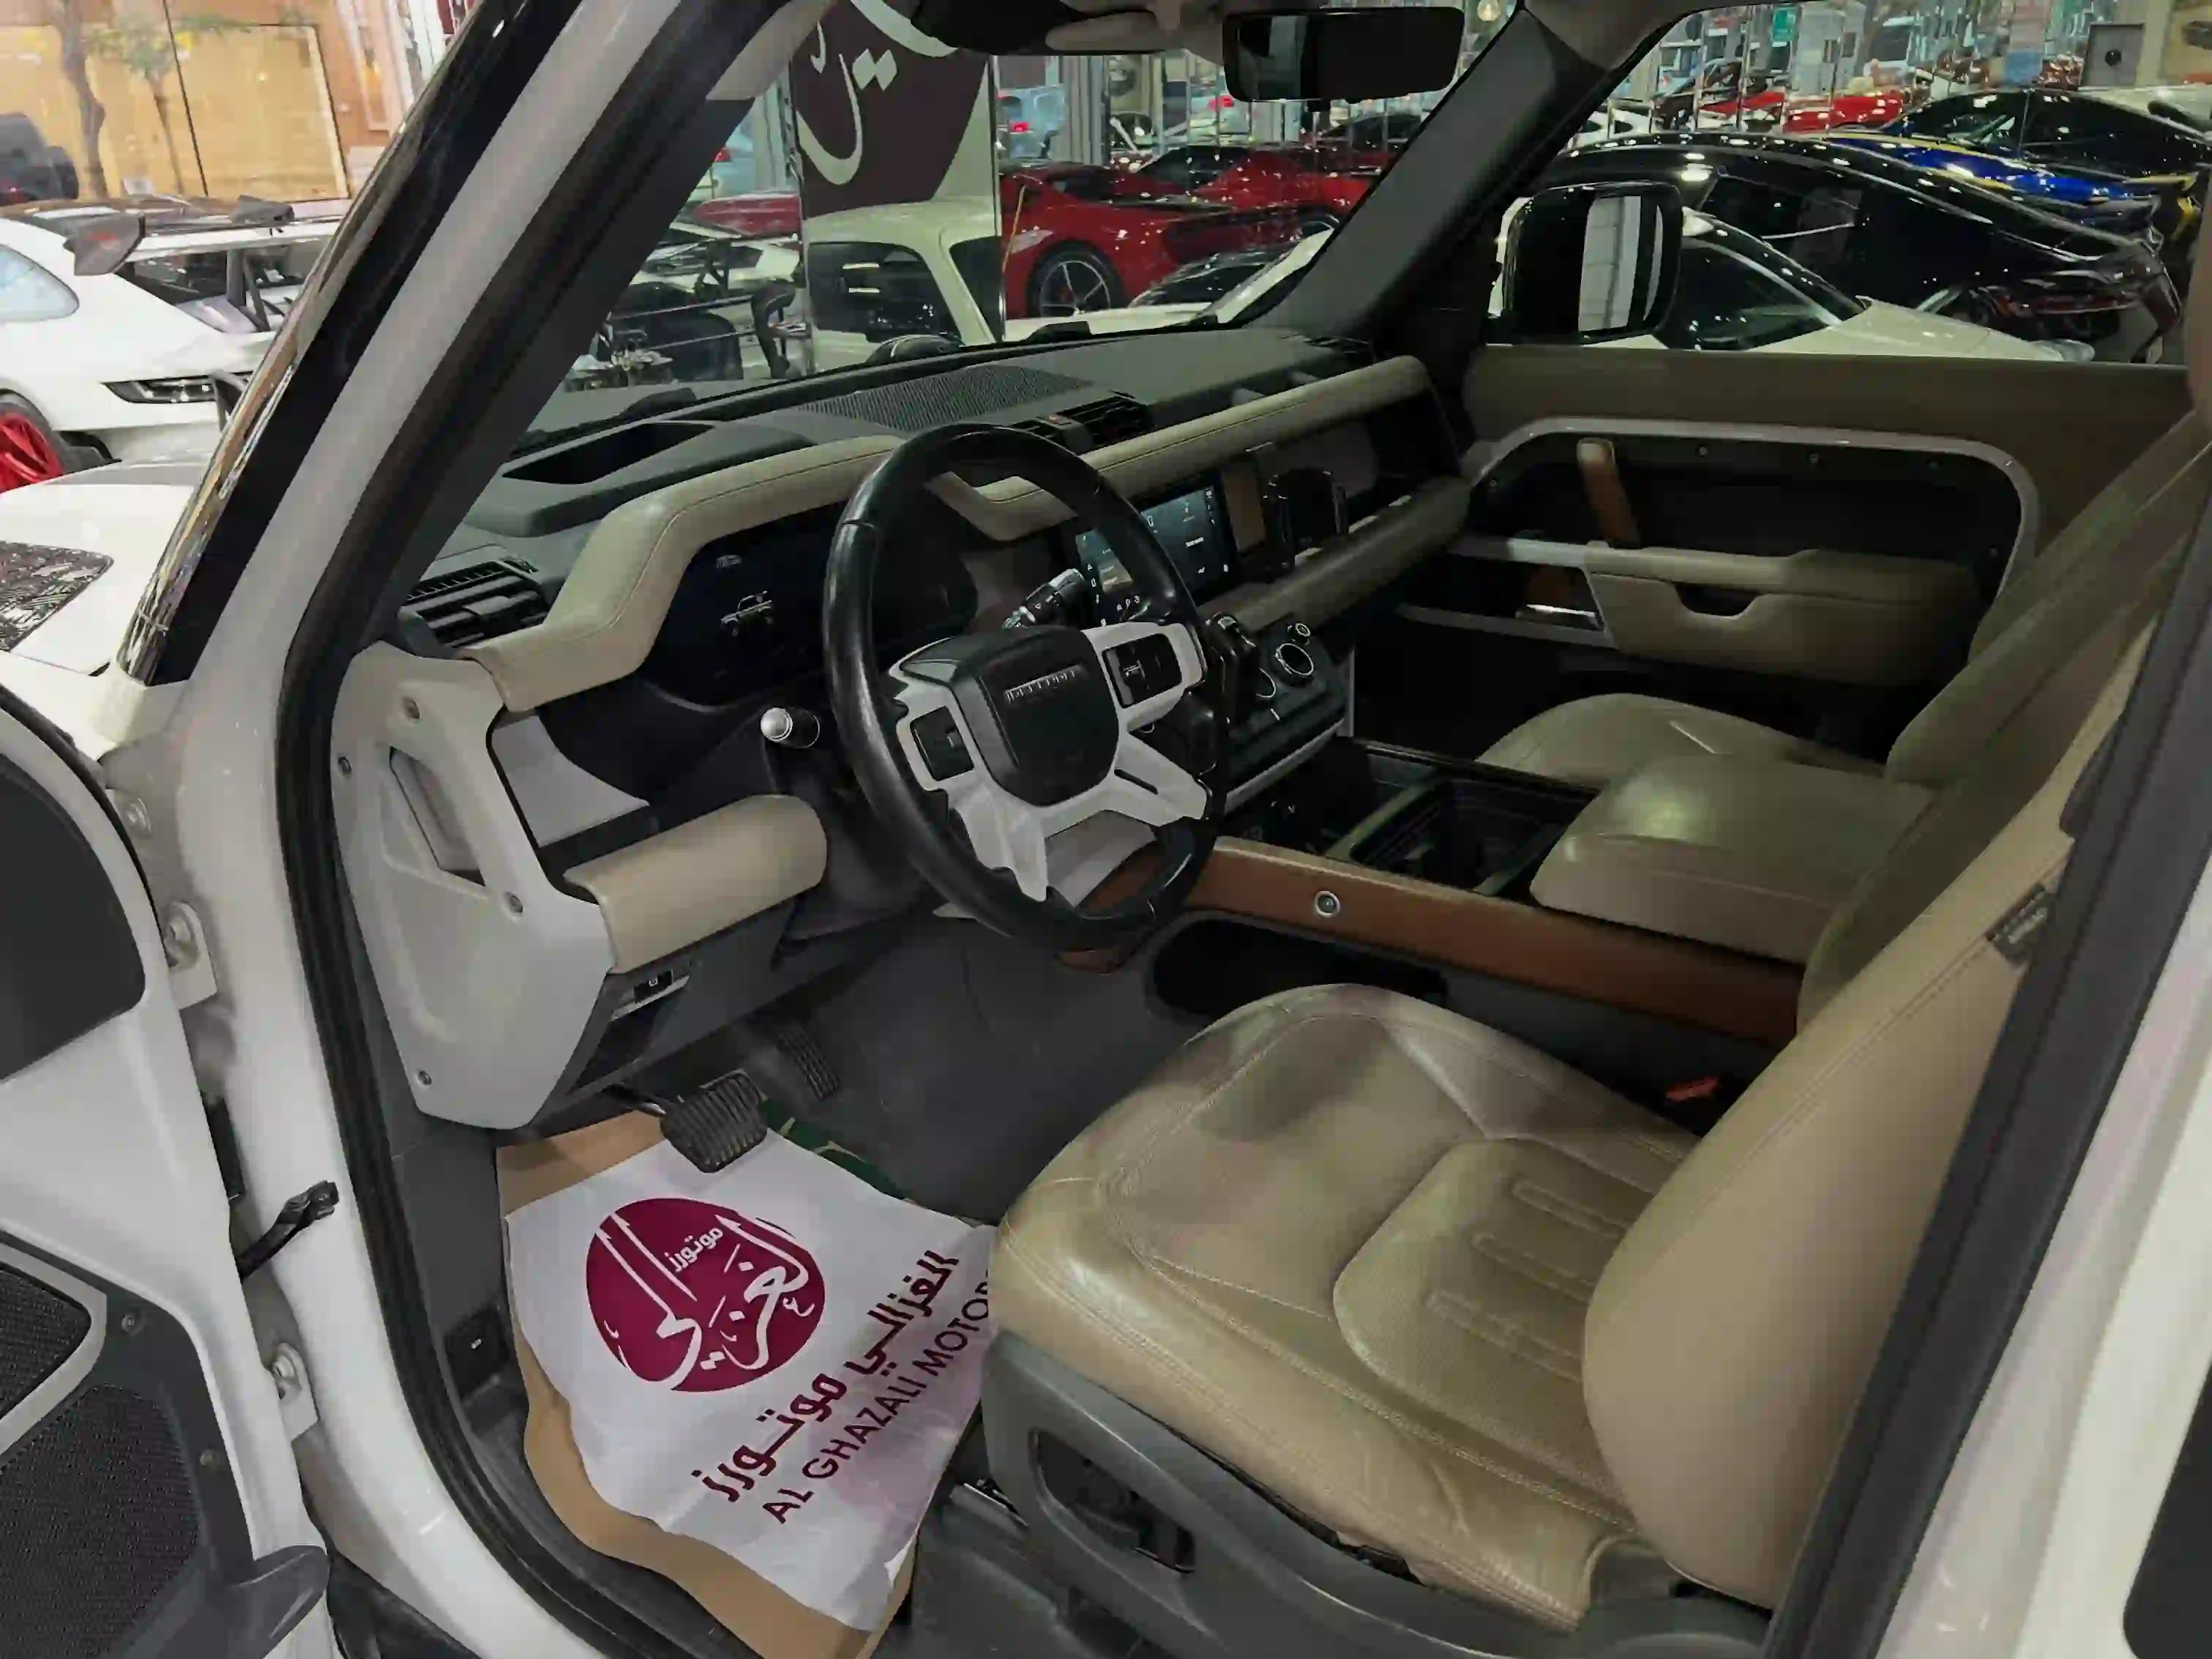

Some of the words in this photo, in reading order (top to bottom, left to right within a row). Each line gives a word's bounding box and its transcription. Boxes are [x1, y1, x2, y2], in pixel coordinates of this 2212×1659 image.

[664, 1227, 723, 1272] موتورز
[763, 1487, 815, 1524] AL
[802, 1376, 927, 1479] GHAZALI
[912, 1270, 988, 1377] MOTO
